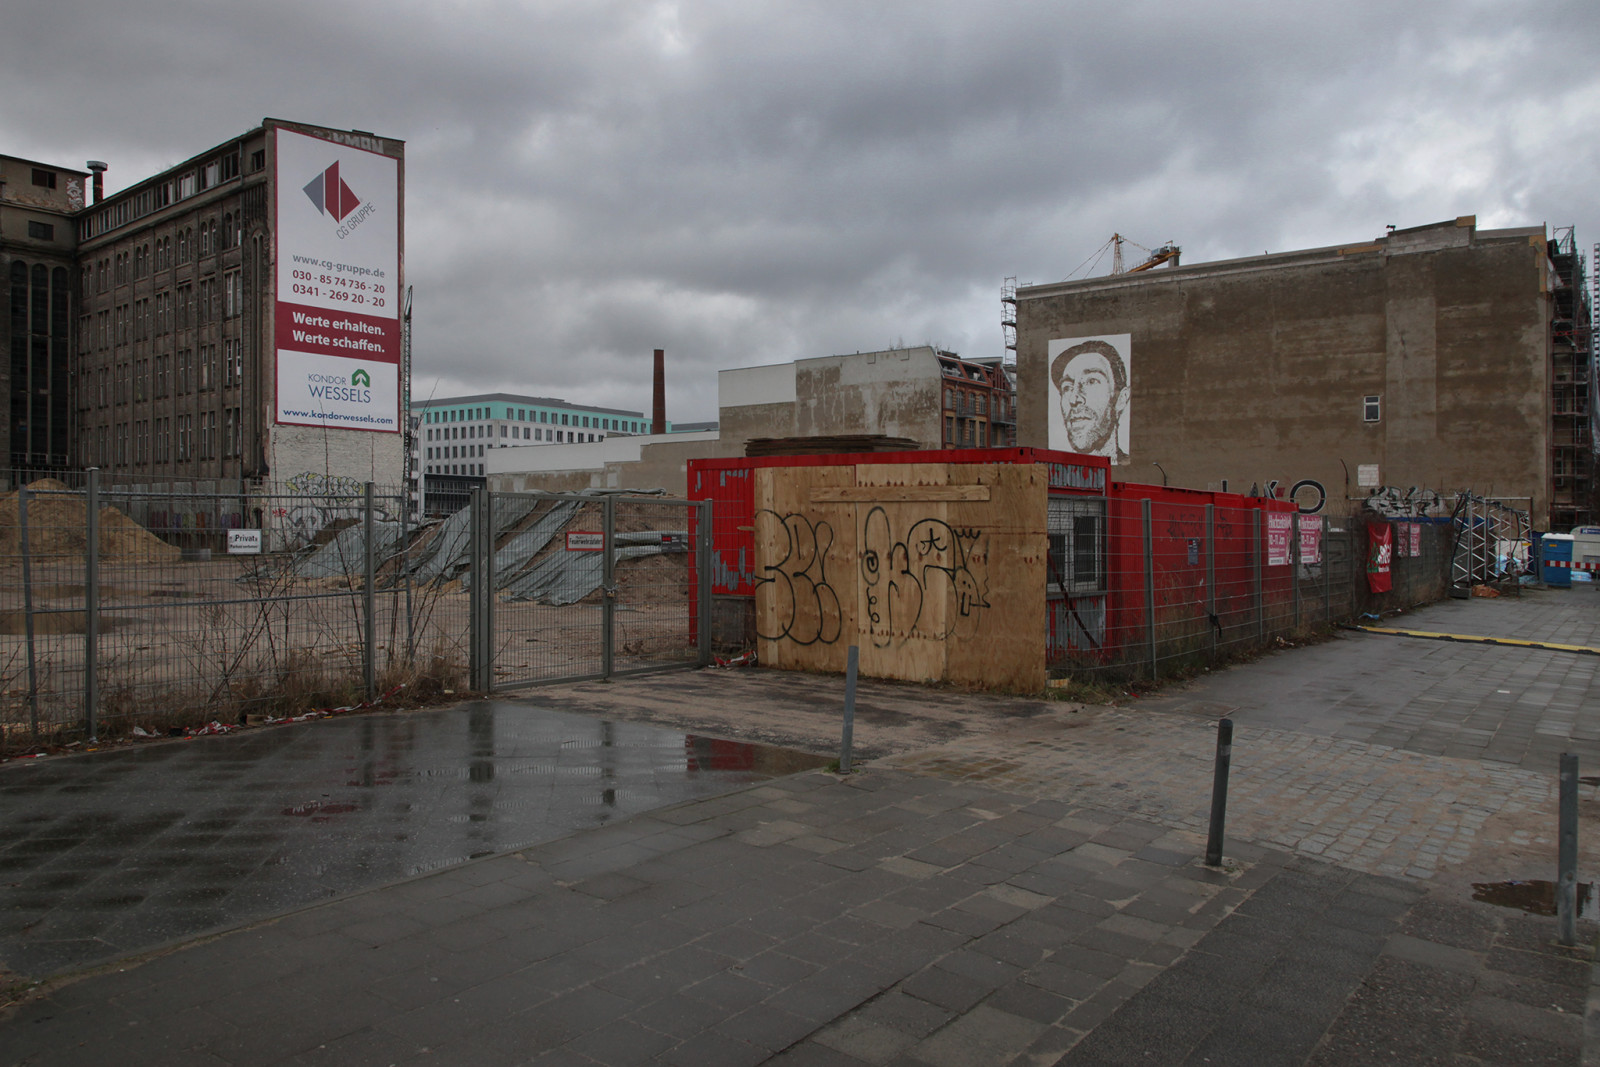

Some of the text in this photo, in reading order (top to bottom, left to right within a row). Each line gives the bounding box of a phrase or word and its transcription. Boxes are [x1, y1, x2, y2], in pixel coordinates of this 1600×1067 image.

[336, 202, 376, 240] CG GRUPPE
[292, 254, 385, 278] www.cg-gruppe.de
[292, 270, 312, 280] 030
[320, 274, 332, 284] 85
[334, 277, 346, 287] 74
[349, 280, 366, 290] 736
[374, 284, 385, 294] 20
[292, 284, 319, 296] 0341
[330, 290, 348, 301] 269
[352, 294, 364, 304] 20
[373, 297, 385, 307] 20
[292, 312, 385, 336] Werte erhalten.
[292, 330, 385, 353] Werte schaffen.
[308, 373, 346, 385] KONDOR
[309, 384, 371, 404] WESSELS
[283, 410, 393, 424] www.kondorwessels.com
